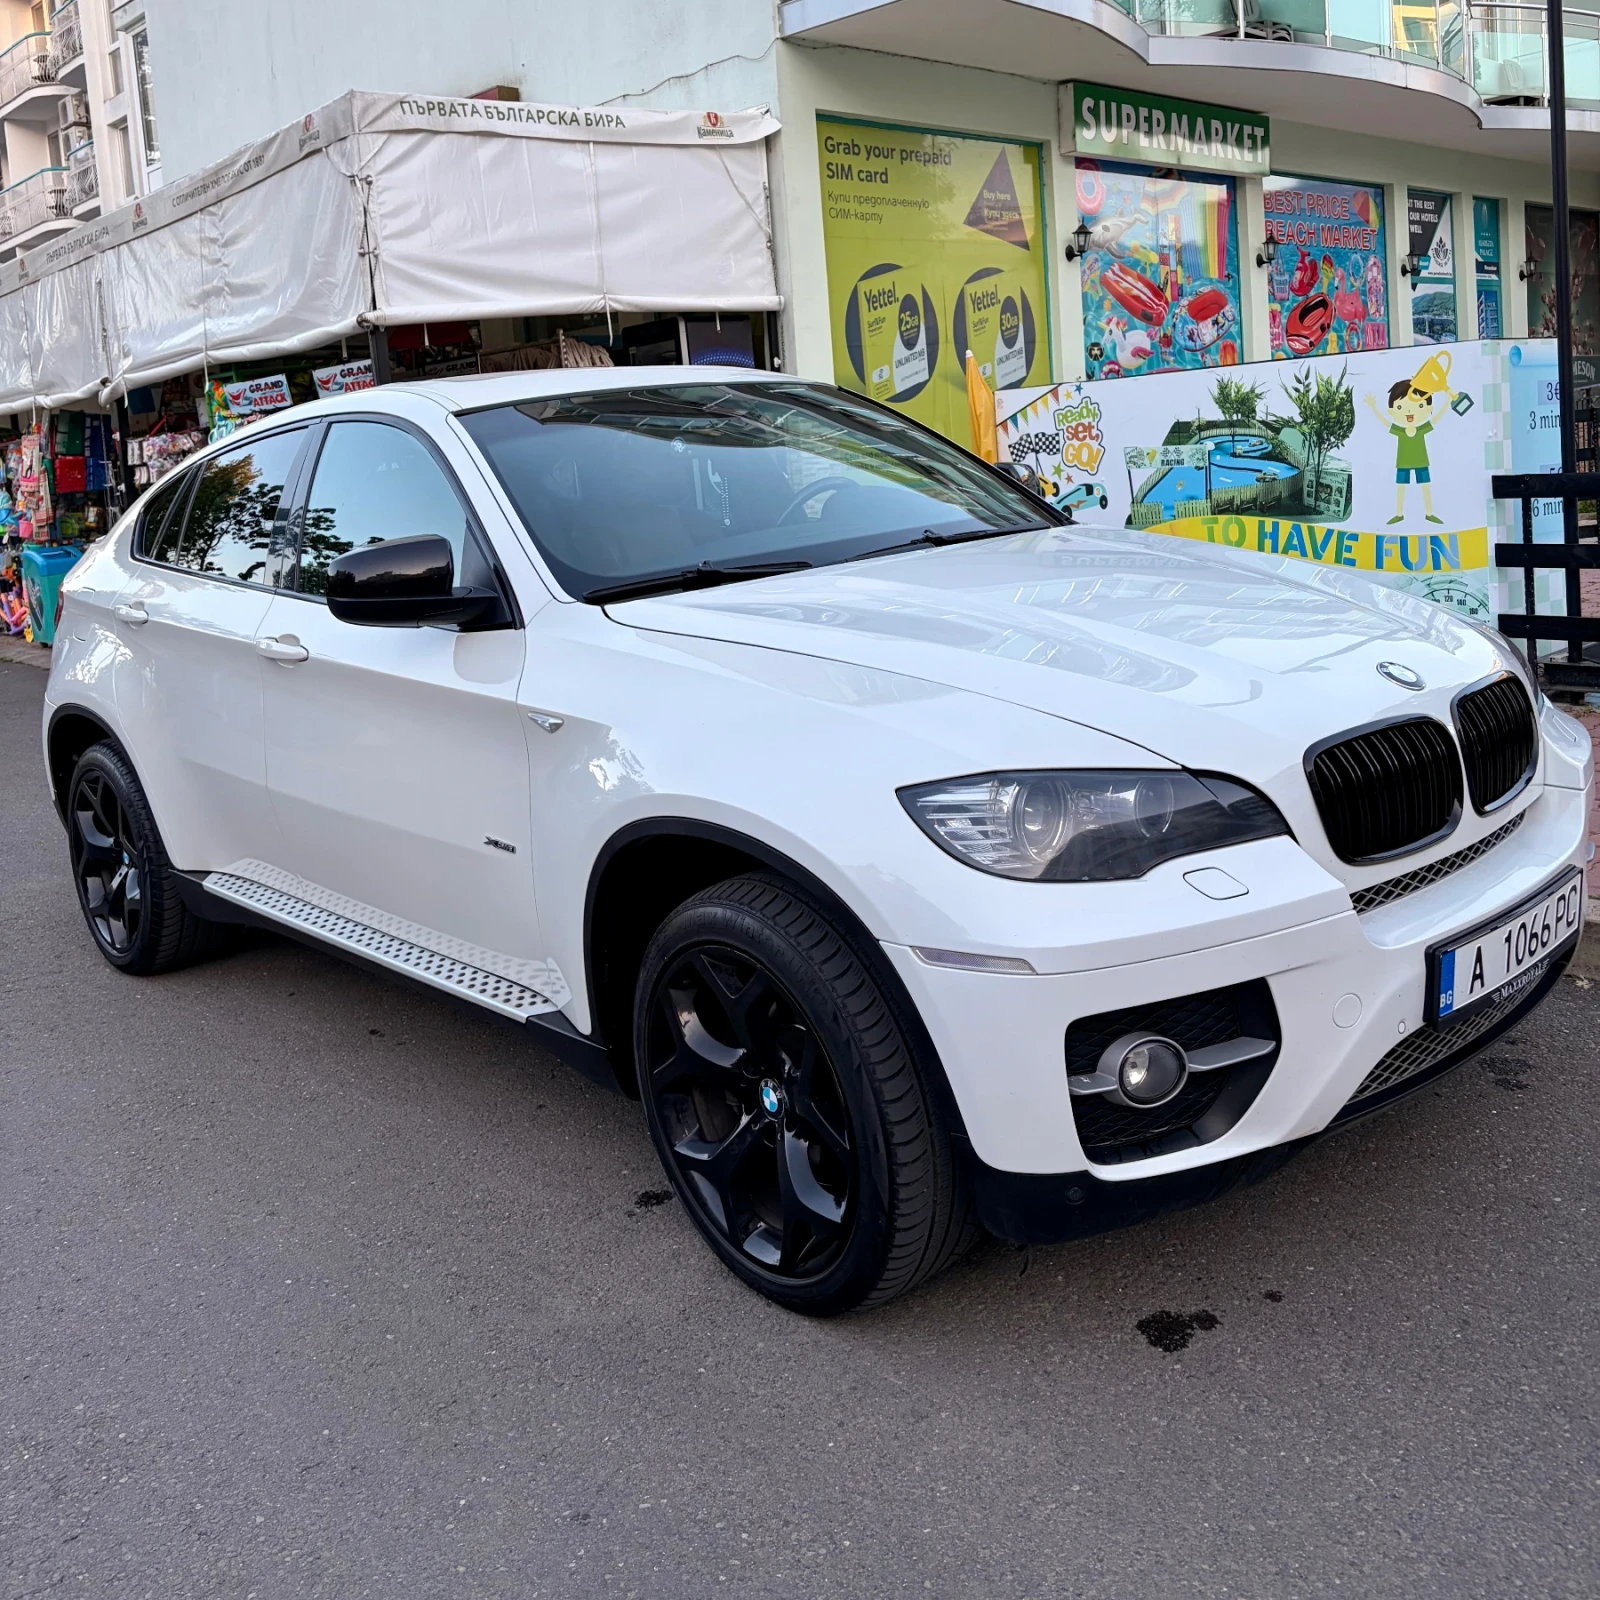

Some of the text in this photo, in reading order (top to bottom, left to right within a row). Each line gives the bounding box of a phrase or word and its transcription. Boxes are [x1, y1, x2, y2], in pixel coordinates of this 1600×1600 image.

[400, 100, 626, 128] ПЪРВАТА БЪЛГАРСКА БИРА
[697, 126, 735, 139] Каменица
[1081, 97, 1265, 163] SUPERMARKET
[824, 136, 952, 167] Grab your prepaid
[826, 162, 889, 184] SIM card
[827, 190, 930, 210] Купи предоплаченную
[983, 190, 1011, 201] Buy here
[1263, 190, 1350, 219] BEST PRICE
[1414, 199, 1423, 209] THE
[828, 207, 883, 224] СИМ-карту
[1409, 211, 1438, 223] OUR HOTELS
[1264, 219, 1378, 250] BEACH MARKET
[1409, 224, 1423, 234] WELL
[340, 363, 373, 378] GRAN
[1573, 361, 1595, 380] MESON
[249, 379, 284, 394] GRAND
[344, 378, 375, 393] ATTAC
[253, 392, 288, 408] ATTACK
[1530, 411, 1537, 430] 3
[1065, 421, 1100, 443] set,
[1064, 442, 1102, 472] GO!
[1161, 458, 1185, 467] RACING
[1532, 498, 1540, 518] 6
[1201, 516, 1461, 571] TO HAVE FUN
[1469, 884, 1577, 995] A 1066 PC
[1440, 990, 1453, 1008] BG
